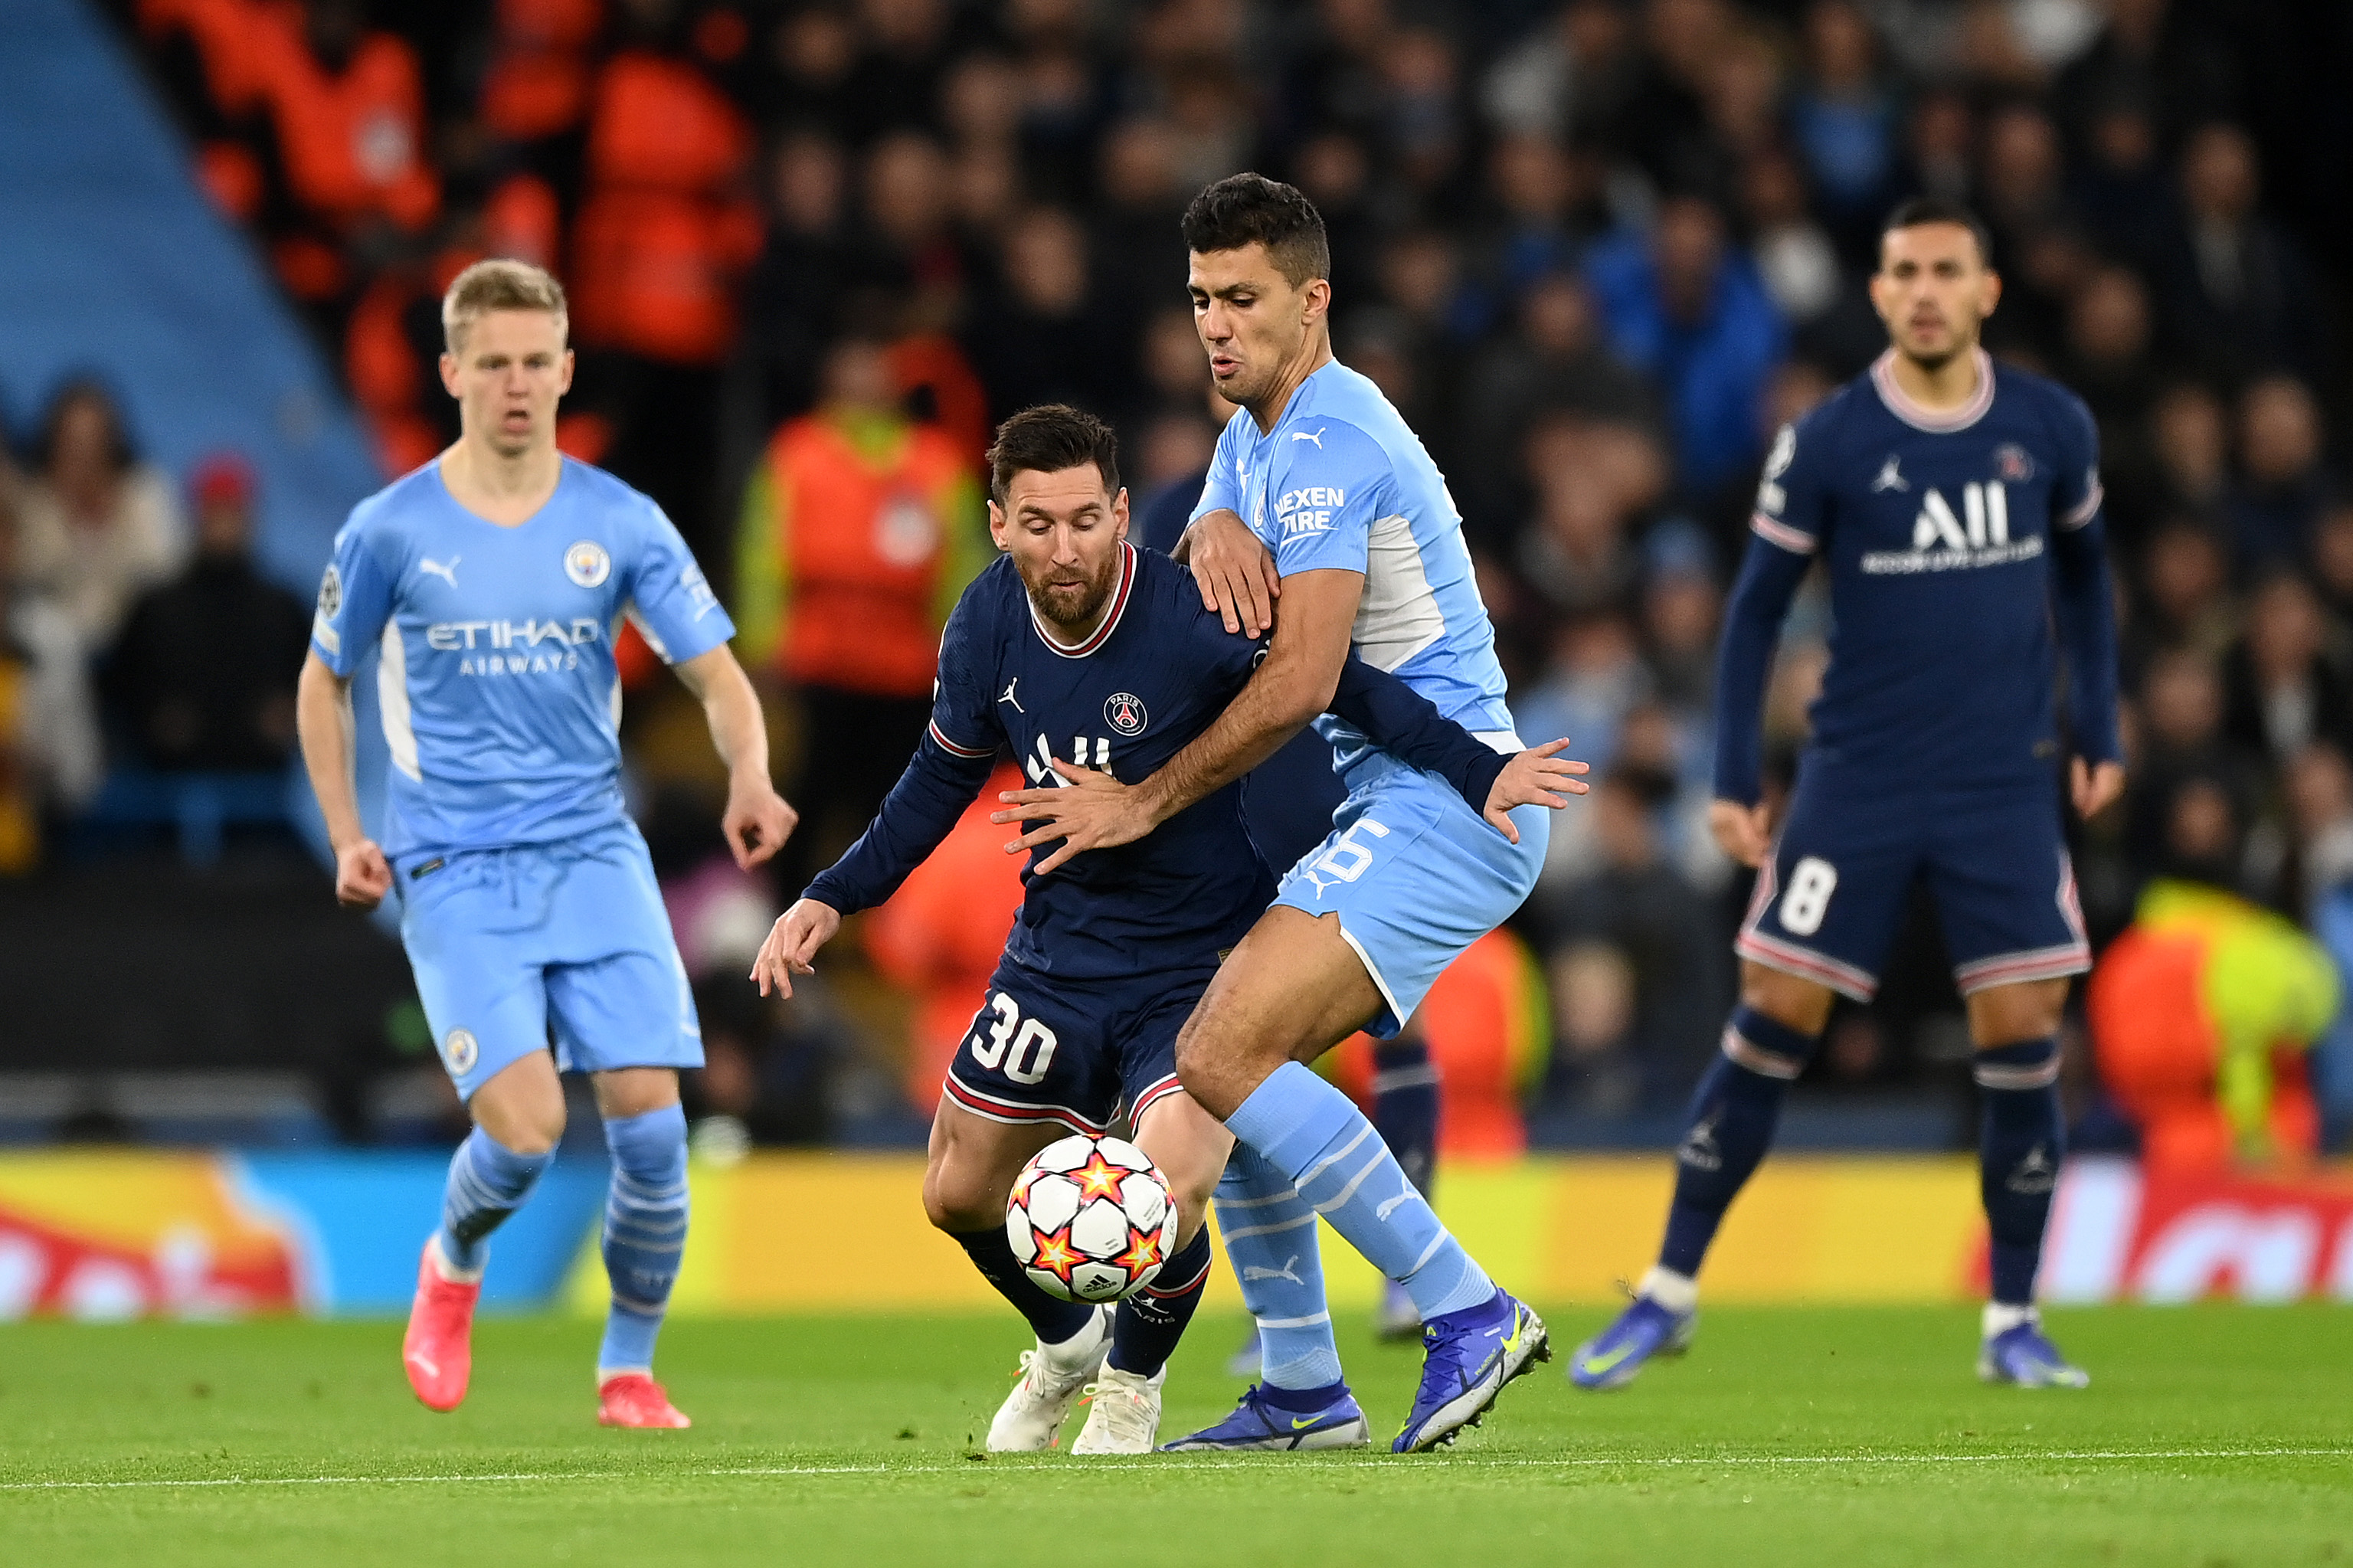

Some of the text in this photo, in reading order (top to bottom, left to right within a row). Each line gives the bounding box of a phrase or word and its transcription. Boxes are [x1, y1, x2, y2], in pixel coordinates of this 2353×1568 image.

[1274, 487, 1344, 519] NEXEN
[1278, 511, 1335, 538] TIRE
[427, 618, 598, 650] ETIHAD
[460, 652, 578, 676] AIRWAYS
[1110, 695, 1139, 707] PARIS
[1779, 856, 1838, 936] 8
[972, 992, 1058, 1085] 30
[1082, 1281, 1117, 1293] adidas
[1126, 1297, 1176, 1324] ARIS
